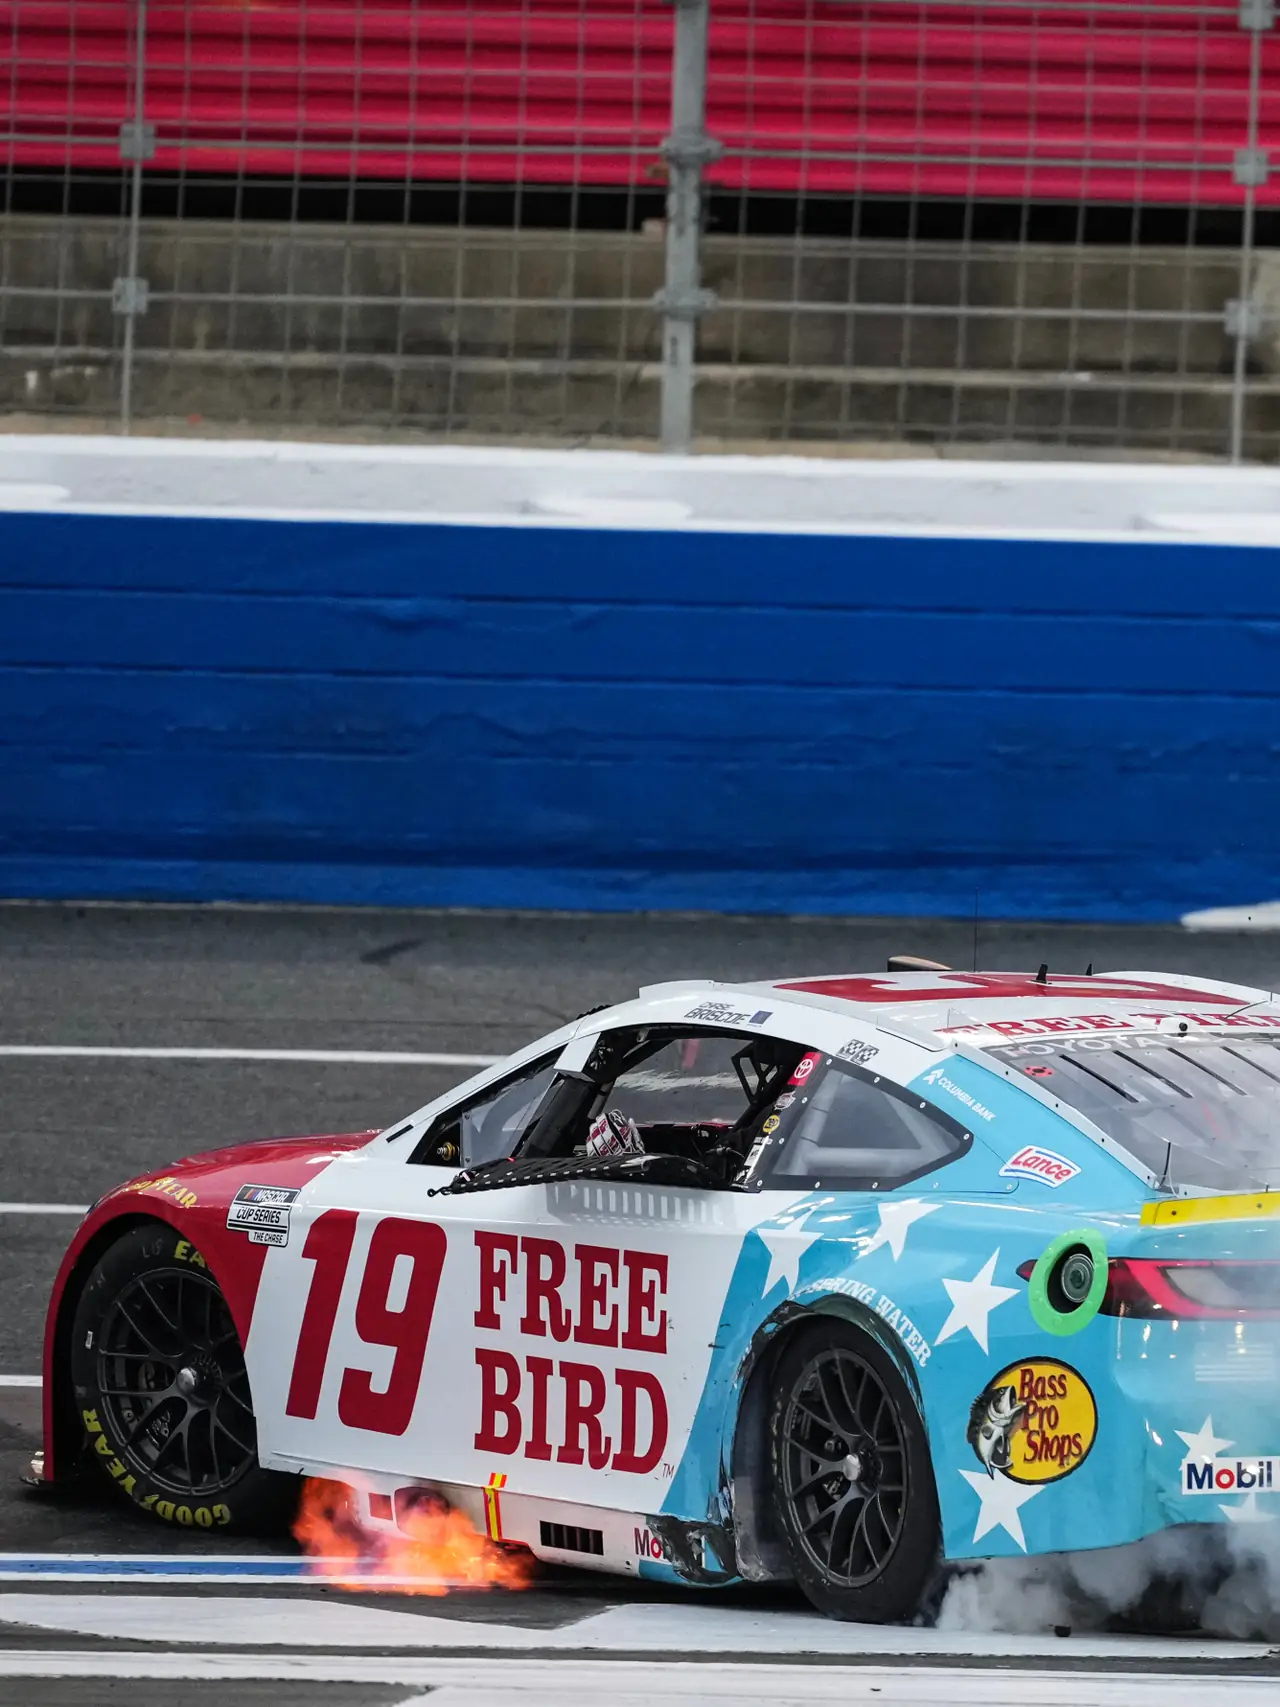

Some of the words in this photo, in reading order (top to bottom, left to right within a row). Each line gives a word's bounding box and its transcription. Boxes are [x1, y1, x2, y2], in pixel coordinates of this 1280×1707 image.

[684, 1007, 751, 1024] BRISCOE
[932, 1014, 1134, 1037] FREE
[991, 1034, 1171, 1057] TOYOTA
[938, 1077, 976, 1107] COLUMBIA
[971, 1102, 997, 1122] BANK
[1011, 1147, 1073, 1181] Lance
[255, 1189, 288, 1203] NASCAR
[237, 1207, 253, 1220] CUP
[253, 1209, 281, 1224] SERIES
[253, 1231, 264, 1241] THE
[264, 1232, 283, 1244] CHASE
[174, 1239, 207, 1269] EA
[474, 1230, 669, 1354] FREE
[285, 1208, 448, 1436] 19
[875, 1294, 932, 1367] WATER
[1018, 1368, 1068, 1400] Bass
[474, 1347, 669, 1475] BIRD
[1021, 1400, 1060, 1431] Pro
[1023, 1430, 1083, 1467] Shops
[82, 1407, 231, 1528] GOODYEAR
[1186, 1461, 1272, 1490] Mobil
[634, 1527, 667, 1560] Mo
